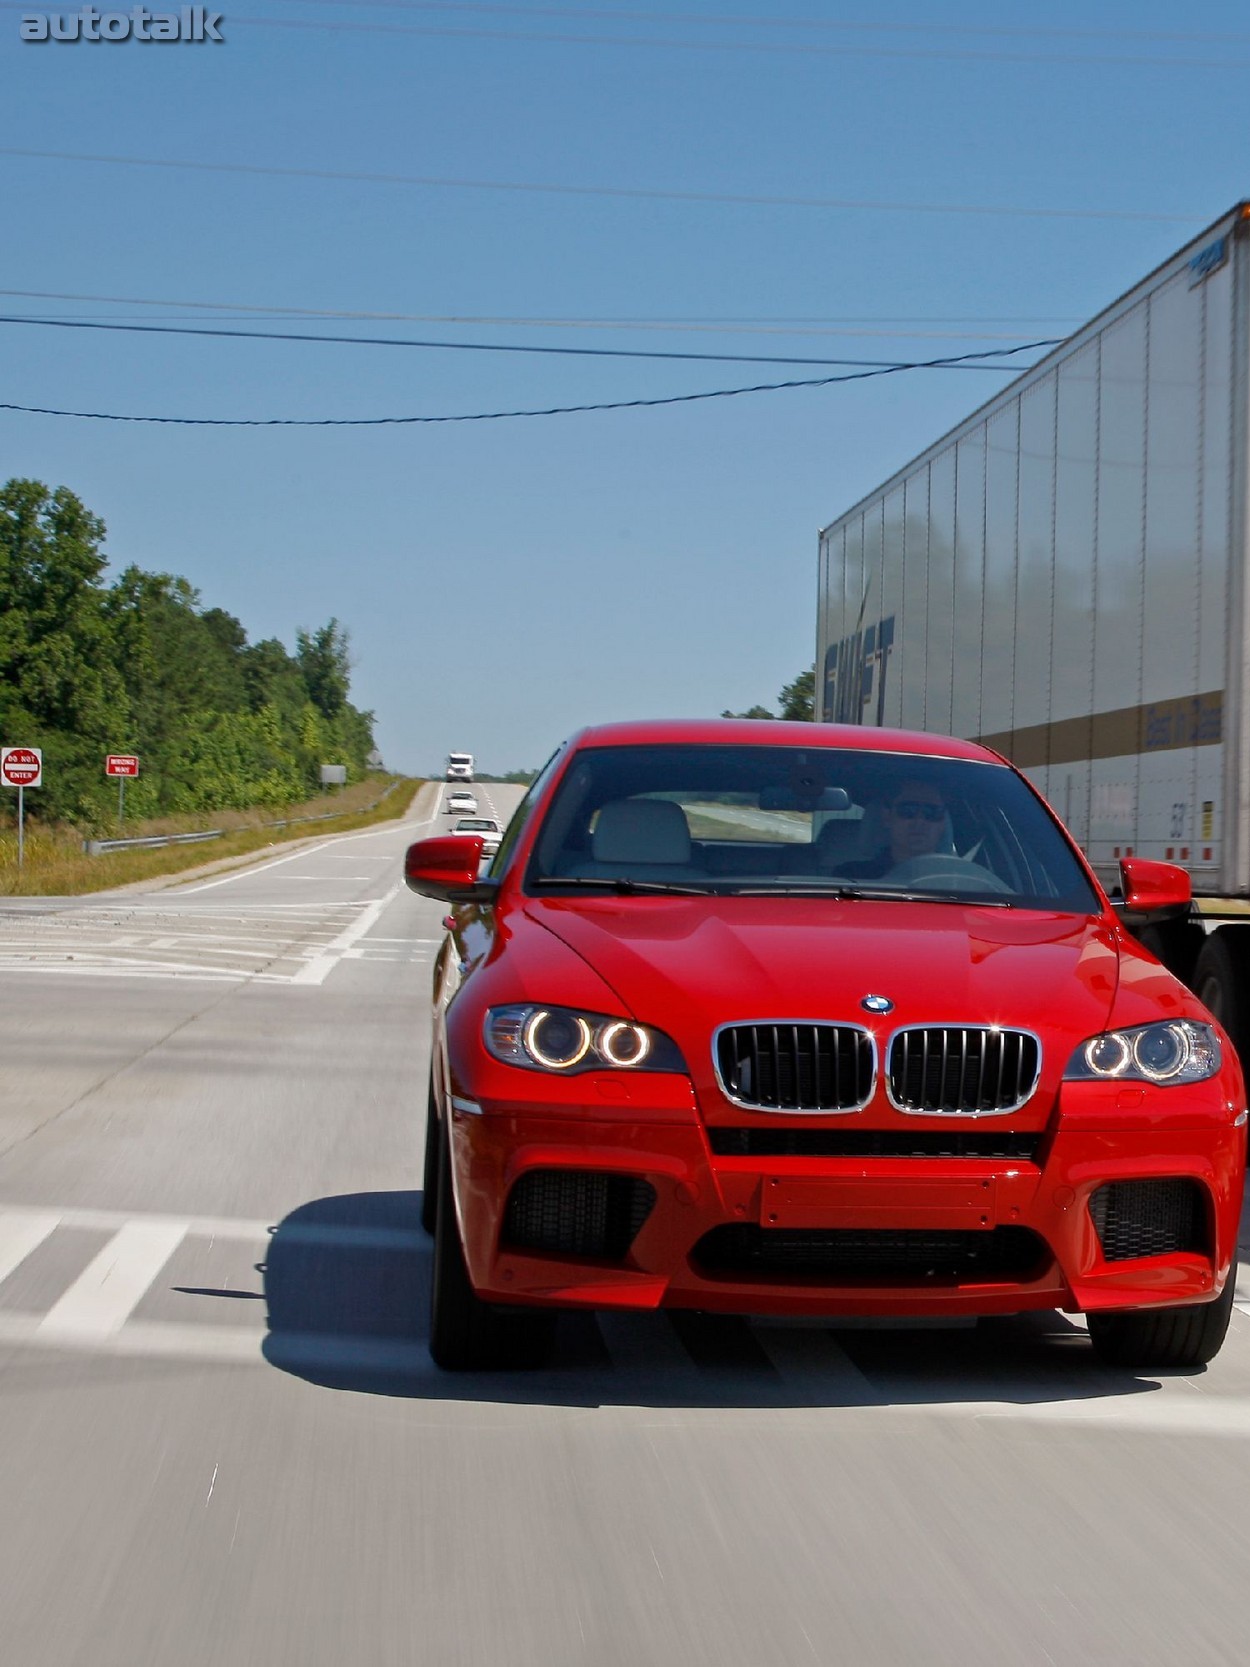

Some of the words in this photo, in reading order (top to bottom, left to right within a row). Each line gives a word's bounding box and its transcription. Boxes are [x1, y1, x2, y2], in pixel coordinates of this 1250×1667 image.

[7, 755, 18, 763] DO
[20, 755, 36, 763] NOT
[9, 771, 33, 779] ENTER
